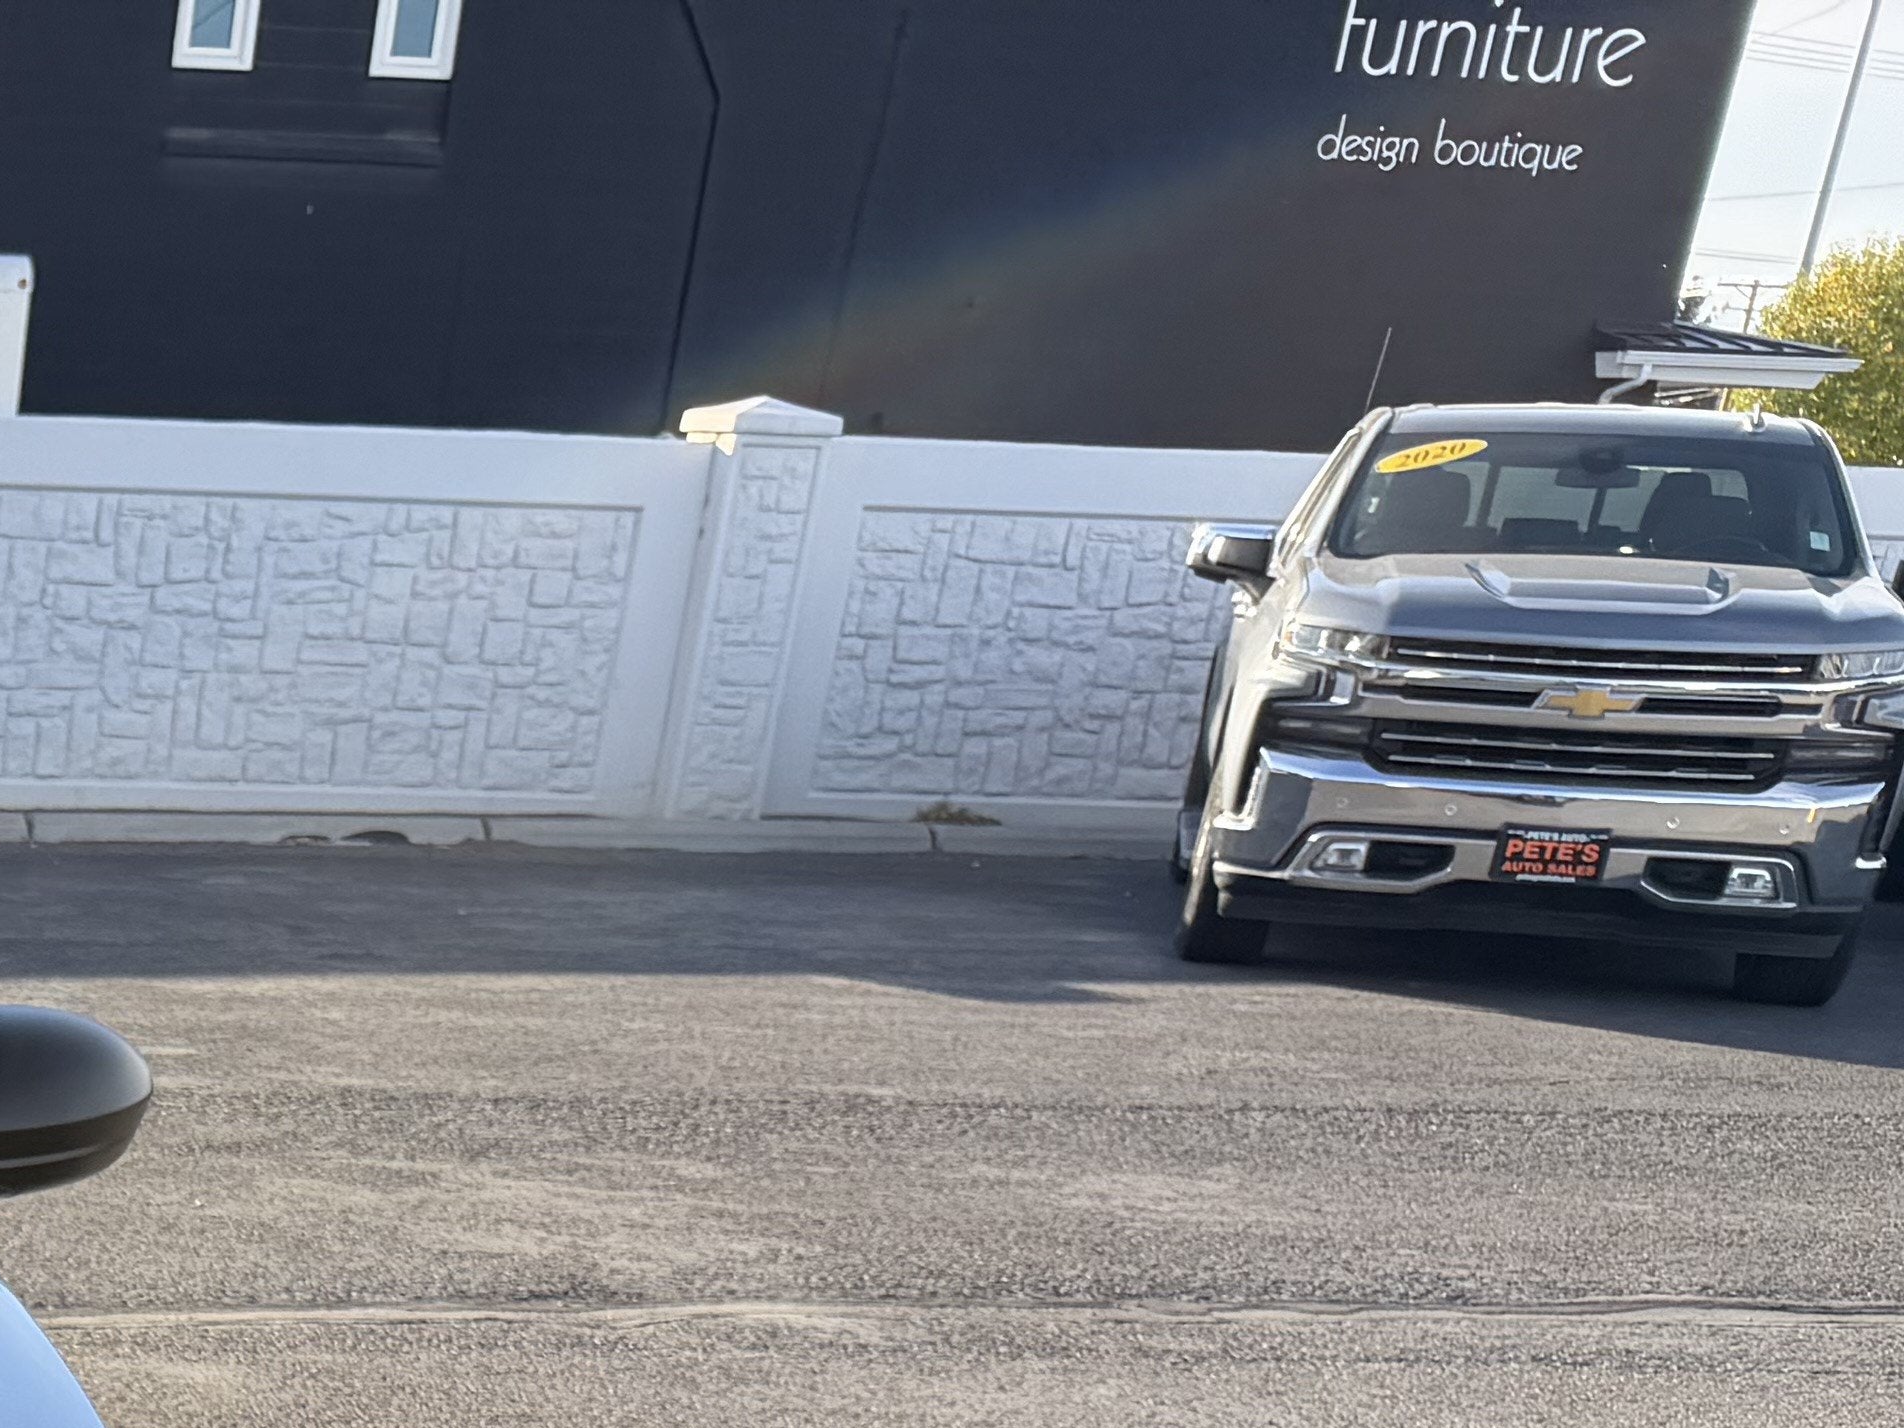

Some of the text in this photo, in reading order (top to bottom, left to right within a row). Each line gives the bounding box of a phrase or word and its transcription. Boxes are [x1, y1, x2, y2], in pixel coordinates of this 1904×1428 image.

[1334, 0, 1647, 87] furniture
[1317, 113, 1583, 178] design boutique
[1396, 442, 1466, 467] 2020
[1505, 839, 1600, 863] PETE'S
